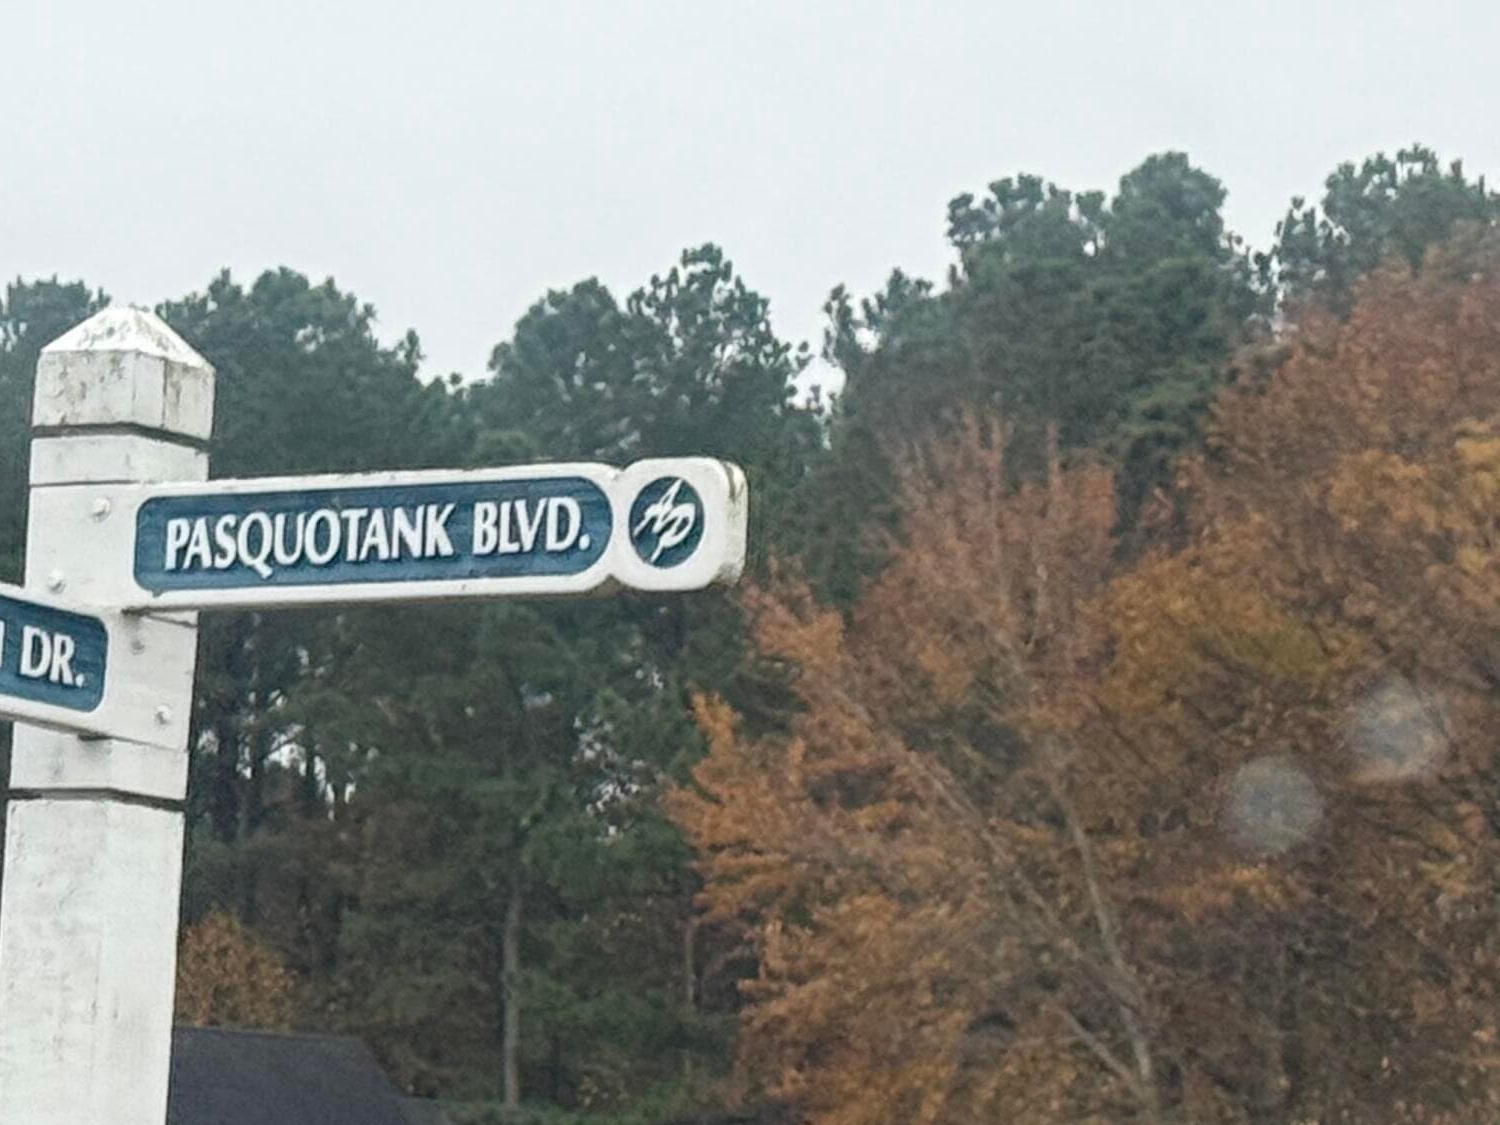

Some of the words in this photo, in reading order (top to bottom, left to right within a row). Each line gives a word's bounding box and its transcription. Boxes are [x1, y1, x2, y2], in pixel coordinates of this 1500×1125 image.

[165, 503, 455, 578] PASQUOTANK
[472, 495, 590, 556] BLVD.
[19, 626, 86, 688] DR.
